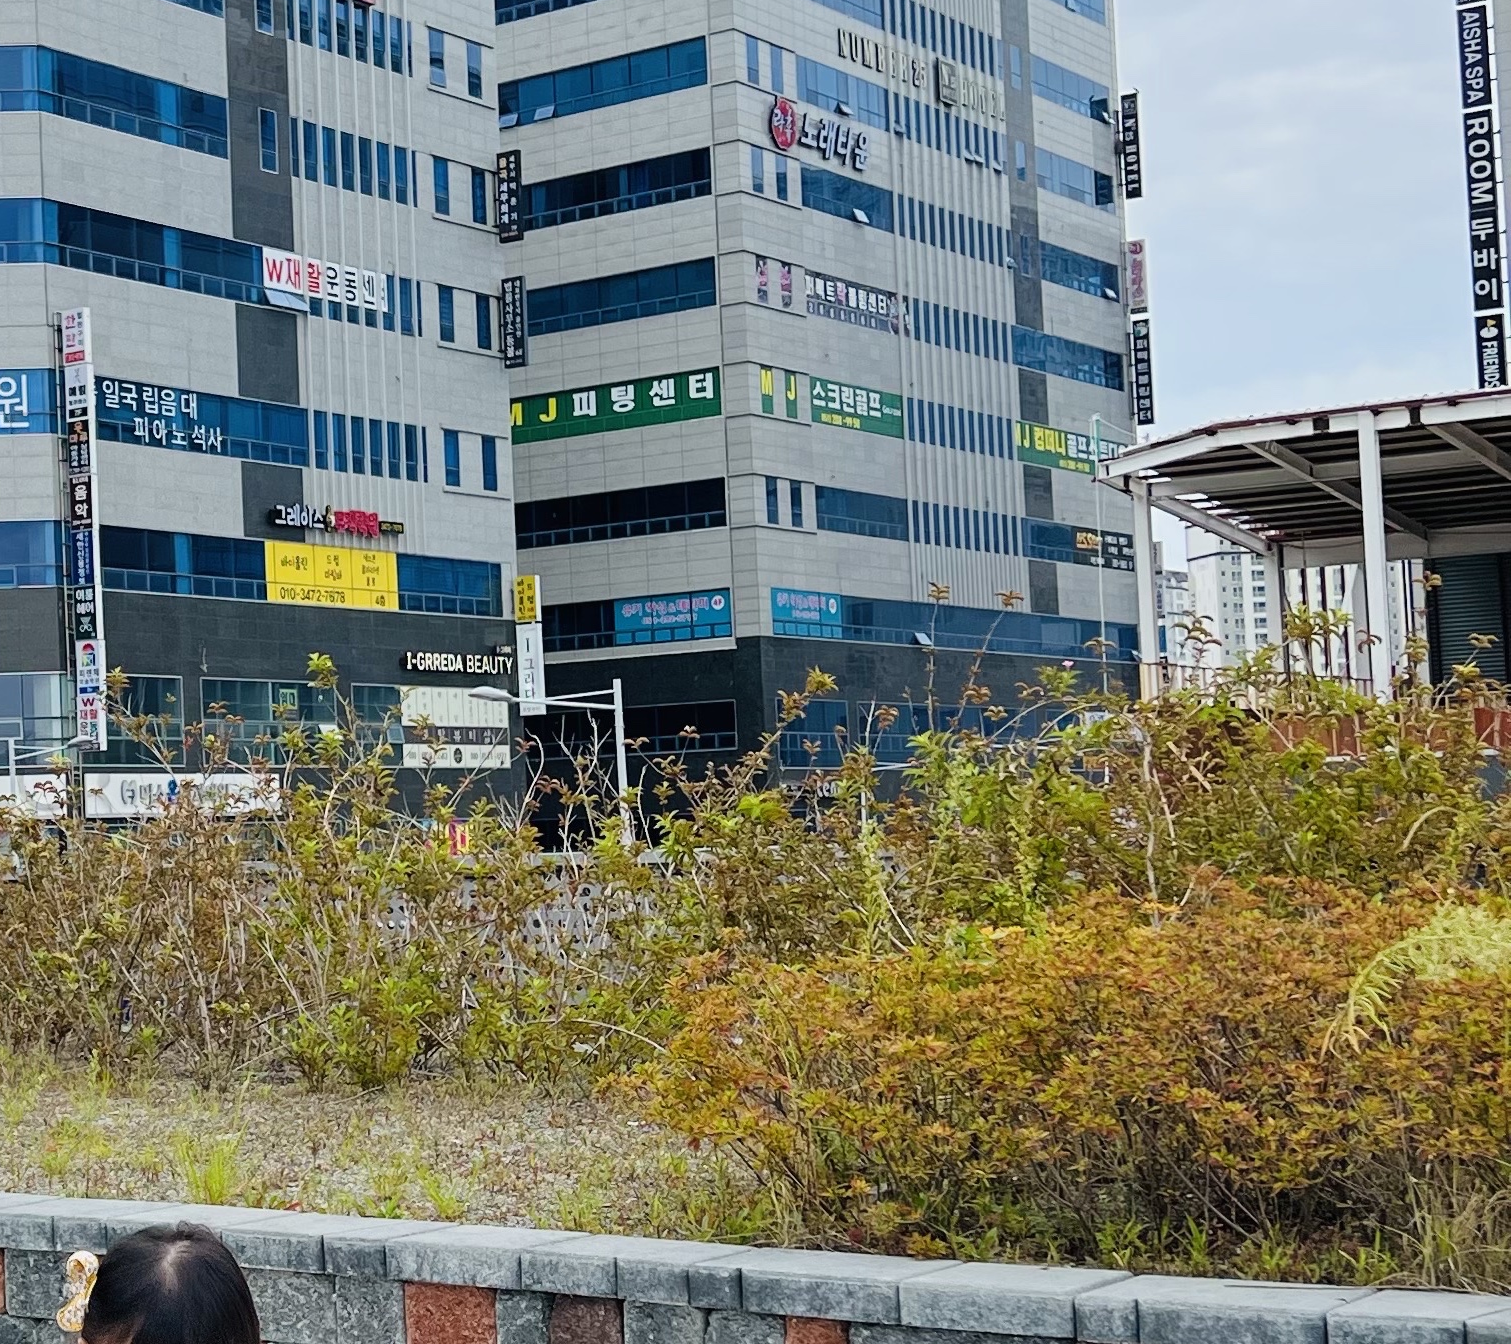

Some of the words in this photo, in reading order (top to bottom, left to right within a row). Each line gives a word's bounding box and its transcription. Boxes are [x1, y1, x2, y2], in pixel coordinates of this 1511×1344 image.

[1462, 11, 1483, 67] AISHA
[839, 29, 908, 83] NUMBER
[961, 79, 1006, 122] HOTEL
[1465, 67, 1485, 104] SPA
[801, 114, 869, 171] 노래타운
[1466, 116, 1494, 205] ROOM
[92, 378, 198, 421] 일국립음대
[572, 372, 715, 418] 피팅센터
[812, 381, 883, 418] 스크린골프
[133, 416, 188, 446] 피아노
[191, 424, 223, 453] 석사
[74, 484, 89, 518] 음악
[274, 503, 326, 529] 그레이스
[406, 651, 464, 673] I-GRREDA
[466, 654, 513, 675] BEAUTY
